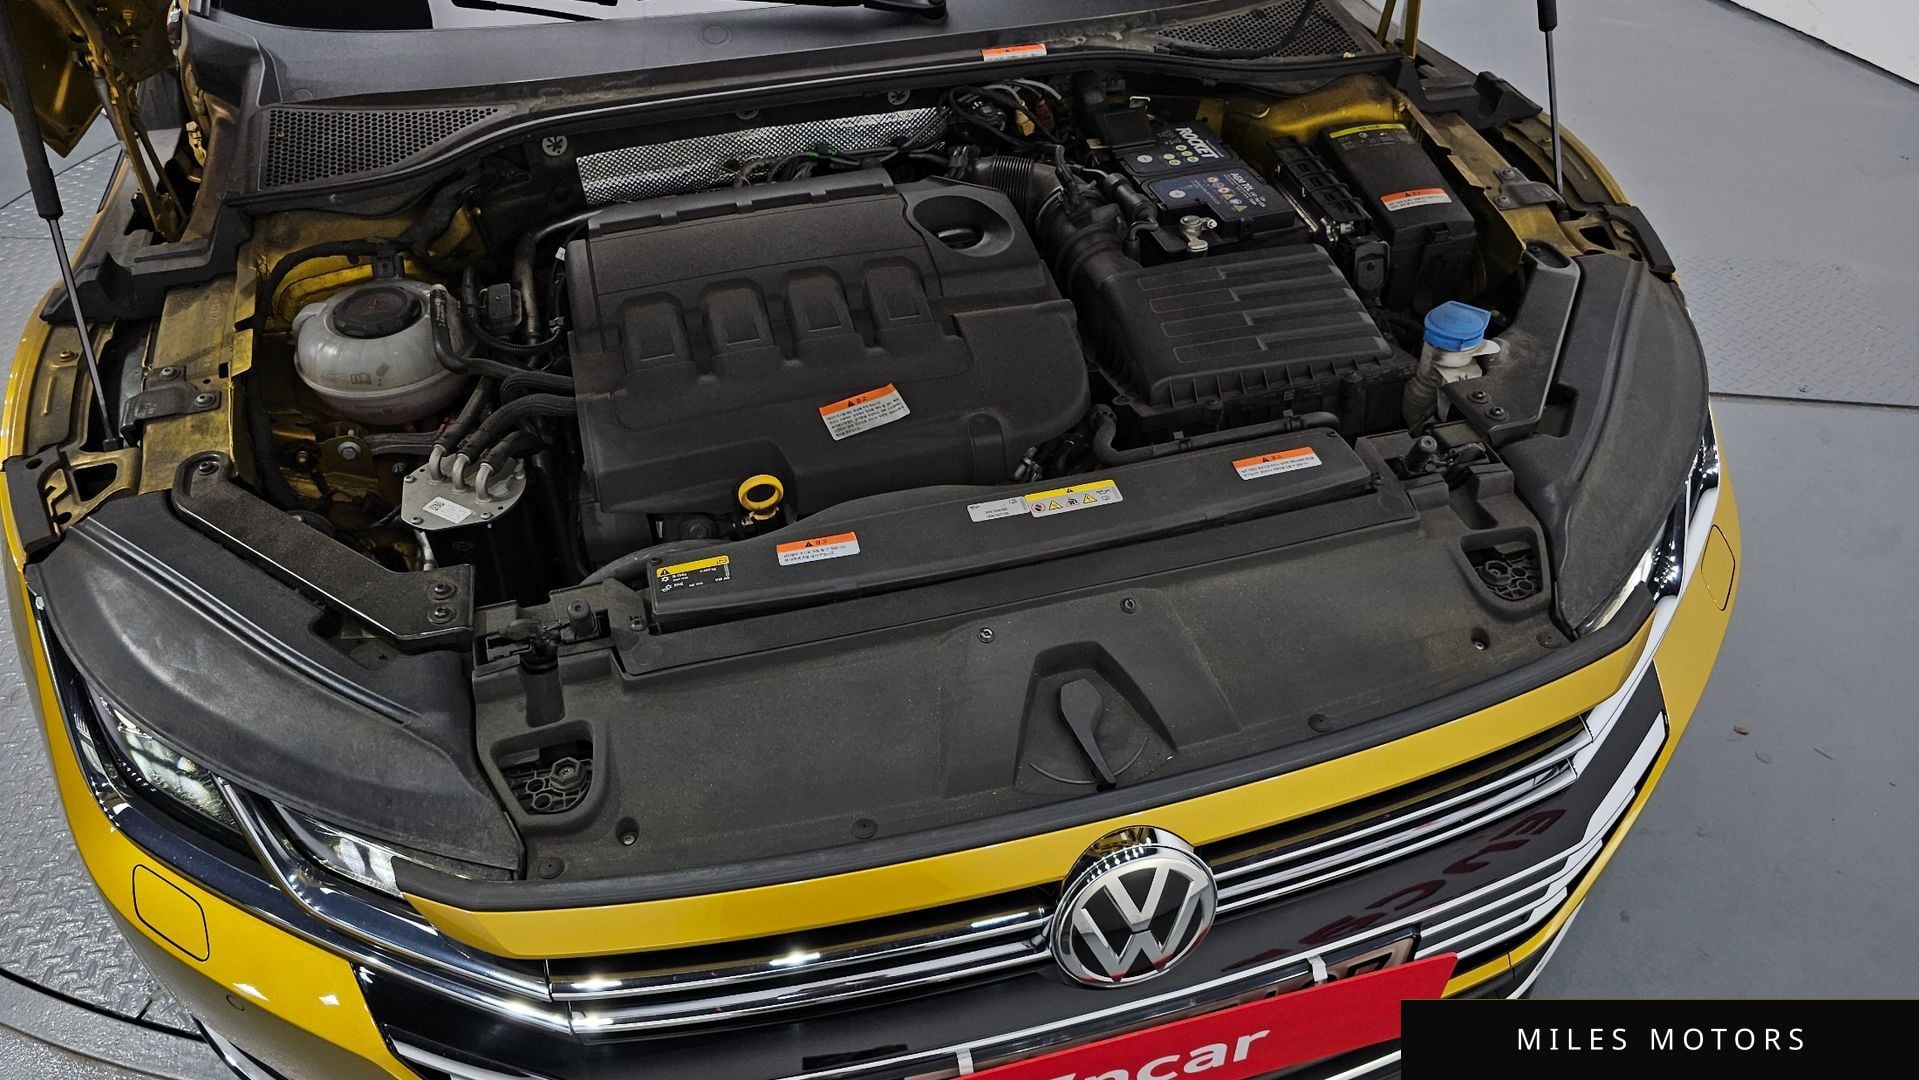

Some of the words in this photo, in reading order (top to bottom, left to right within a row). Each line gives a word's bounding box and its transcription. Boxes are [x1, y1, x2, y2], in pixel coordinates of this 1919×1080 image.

[1175, 127, 1220, 159] ROCKET
[1062, 850, 1212, 984] VW
[1050, 1029, 1271, 1080] car
